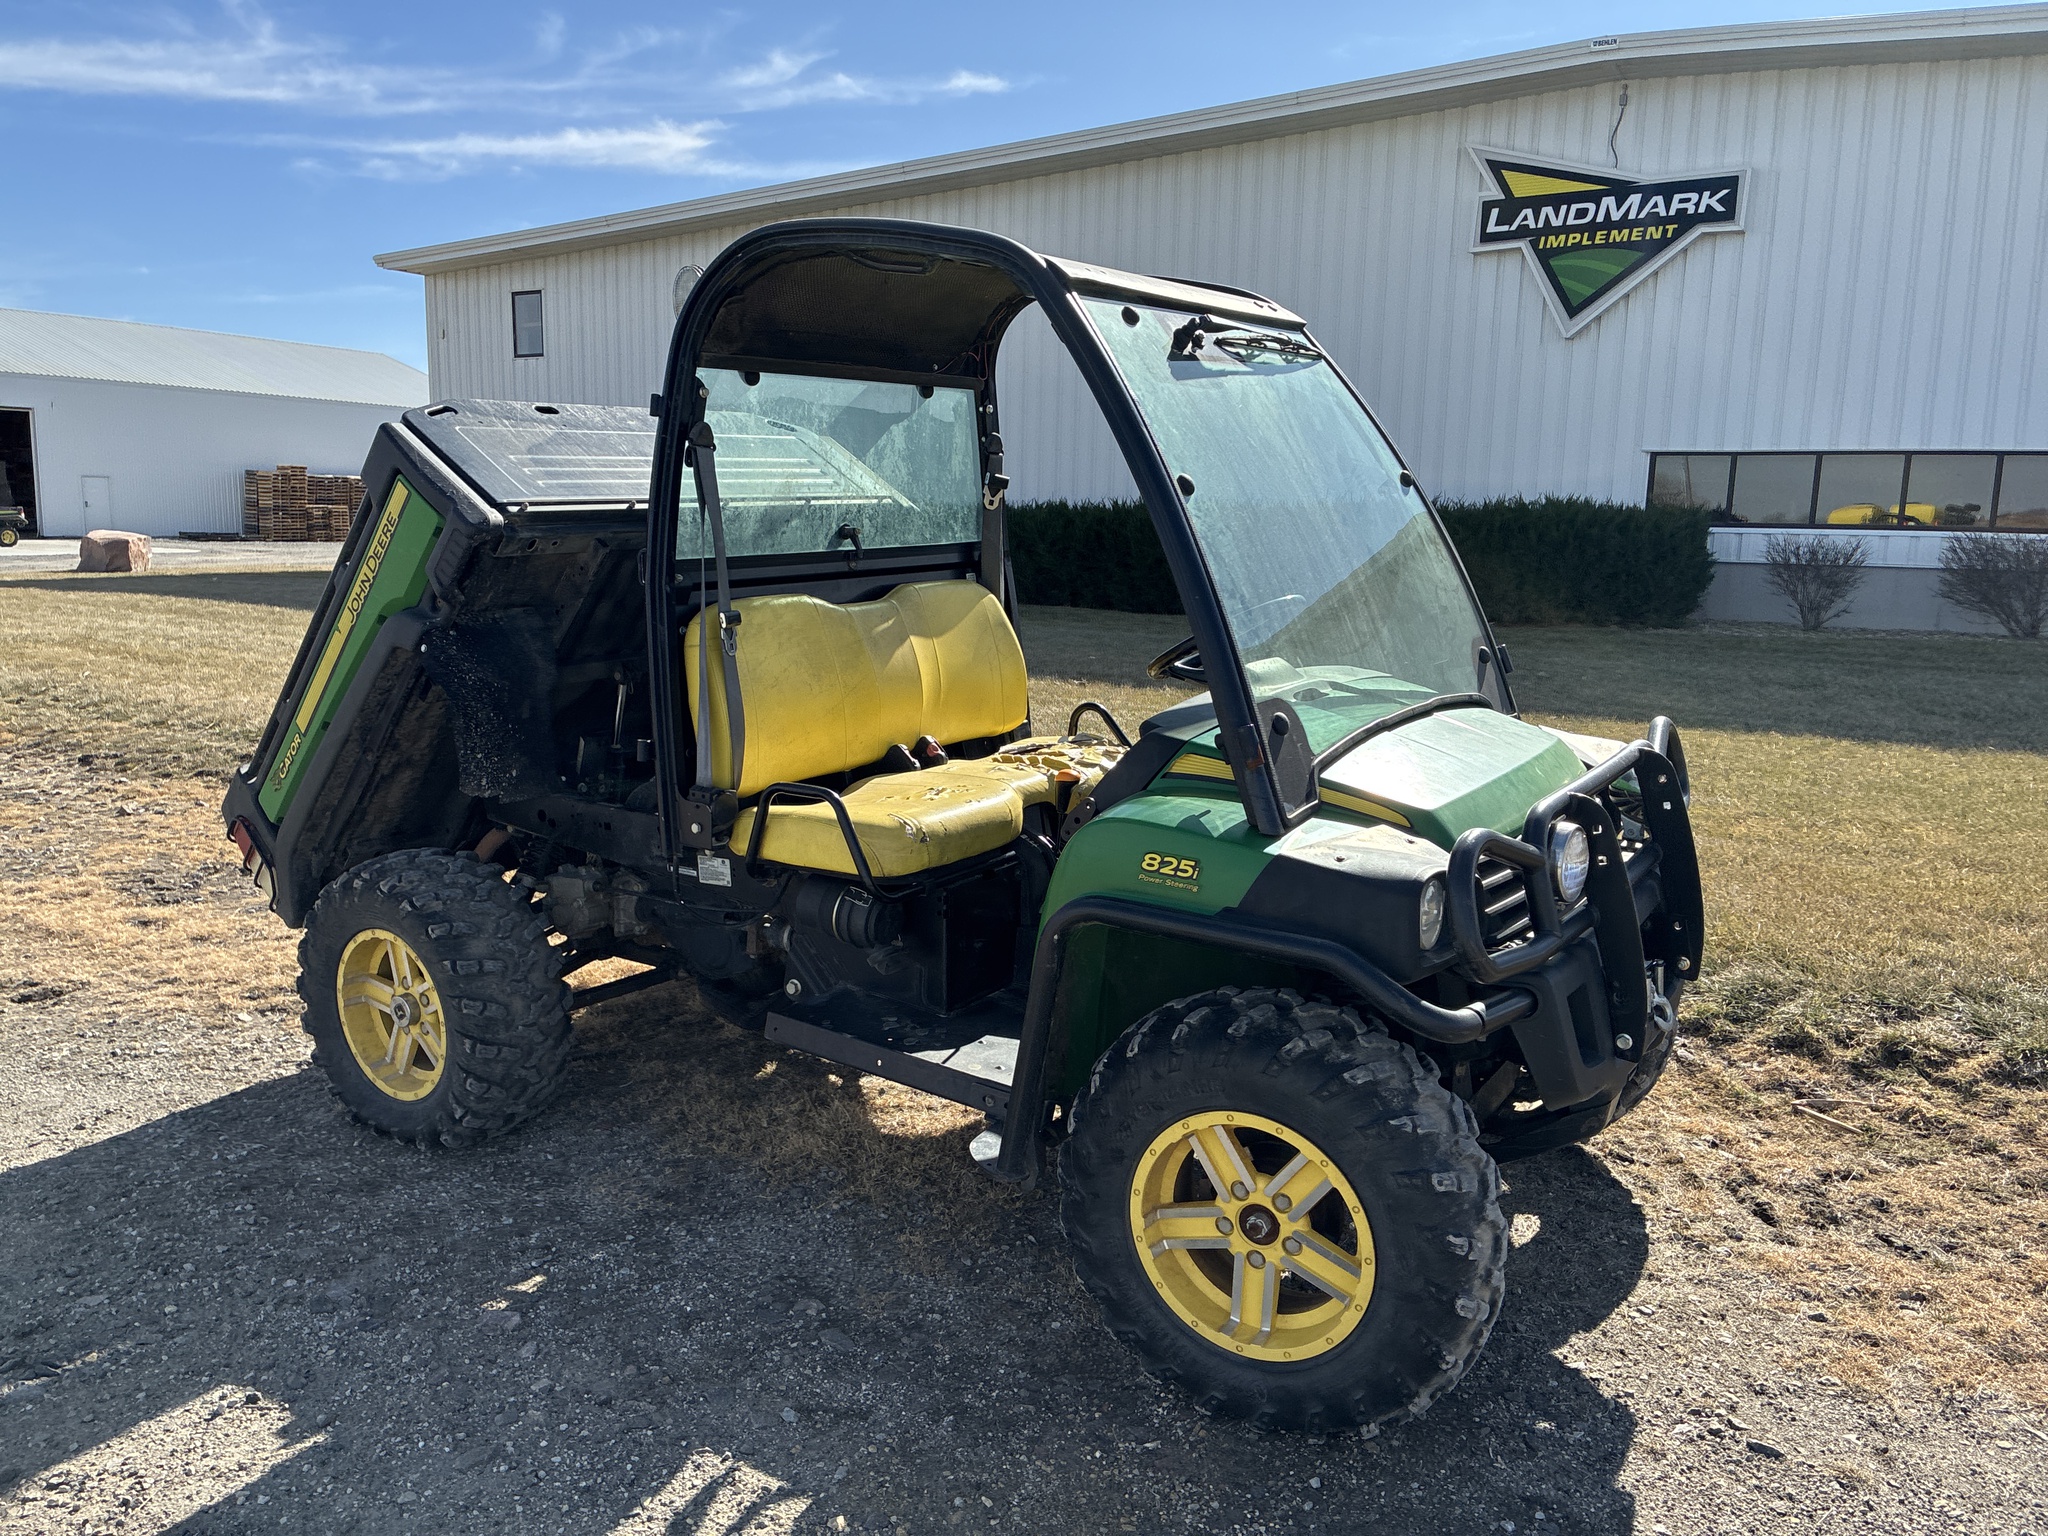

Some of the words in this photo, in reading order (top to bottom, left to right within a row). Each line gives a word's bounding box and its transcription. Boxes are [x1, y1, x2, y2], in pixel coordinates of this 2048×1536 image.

[1538, 224, 1678, 250] IMPLEMENT
[346, 572, 373, 624] JOHN
[365, 511, 397, 574] DEERE
[279, 733, 302, 779] GATOR
[1141, 852, 1199, 879] 825i
[1138, 873, 1163, 885] Power
[1164, 879, 1199, 893] Steering
